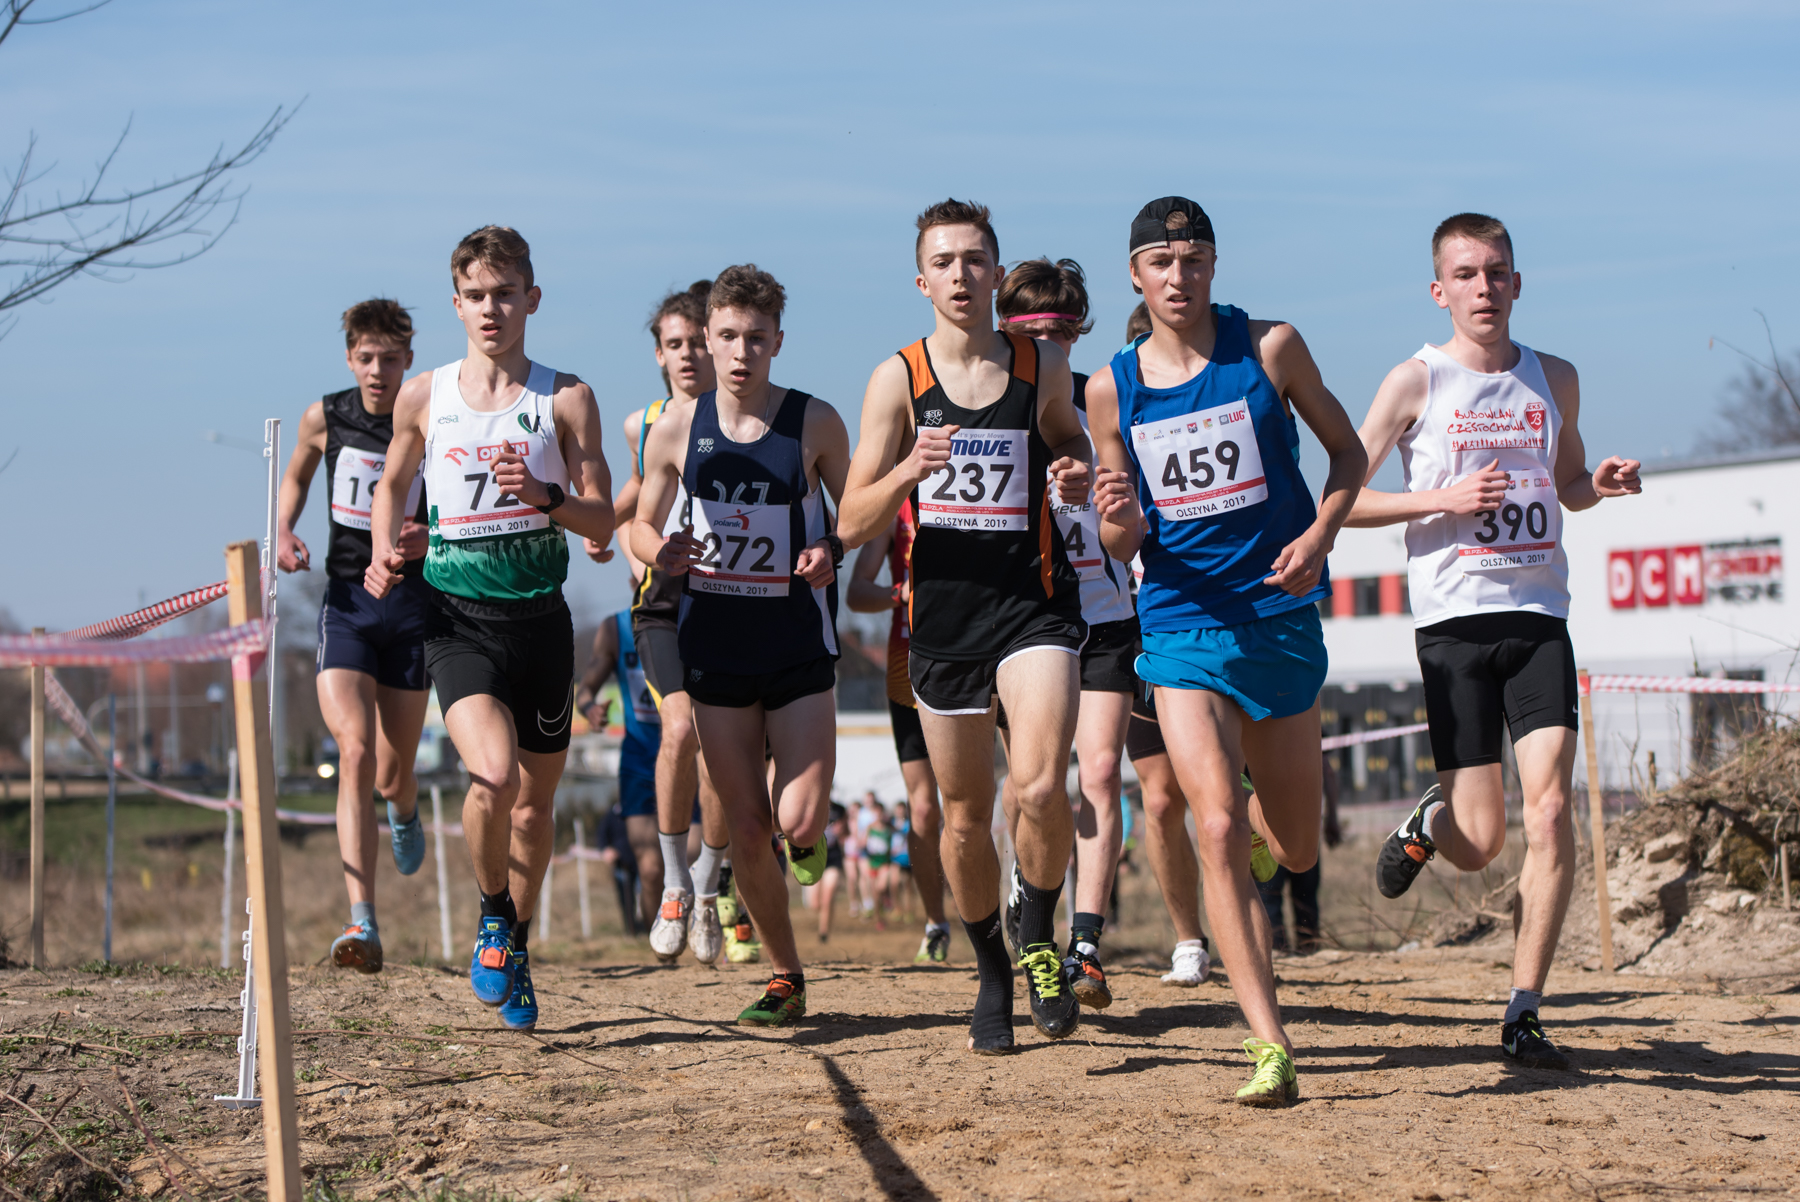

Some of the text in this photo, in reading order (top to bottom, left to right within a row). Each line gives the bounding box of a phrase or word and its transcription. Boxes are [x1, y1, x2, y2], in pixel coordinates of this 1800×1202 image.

[437, 414, 460, 425] esa
[1228, 410, 1246, 423] LUG
[1161, 440, 1241, 492] 459
[931, 462, 1015, 504] 237
[464, 472, 520, 512] 72
[1176, 495, 1246, 518] OLSZYNA 2019
[343, 517, 371, 529] OLSZYN
[459, 520, 530, 537] OLSZYNA 2019
[713, 520, 741, 528] polanik
[935, 516, 1008, 528] OLSZYNA 2019
[1474, 501, 1548, 544] 390
[703, 531, 775, 573] 272
[1480, 553, 1546, 568] OLSZYNA 2019
[1609, 552, 1702, 601] DCM
[701, 581, 769, 595] OLSZYNA 2019
